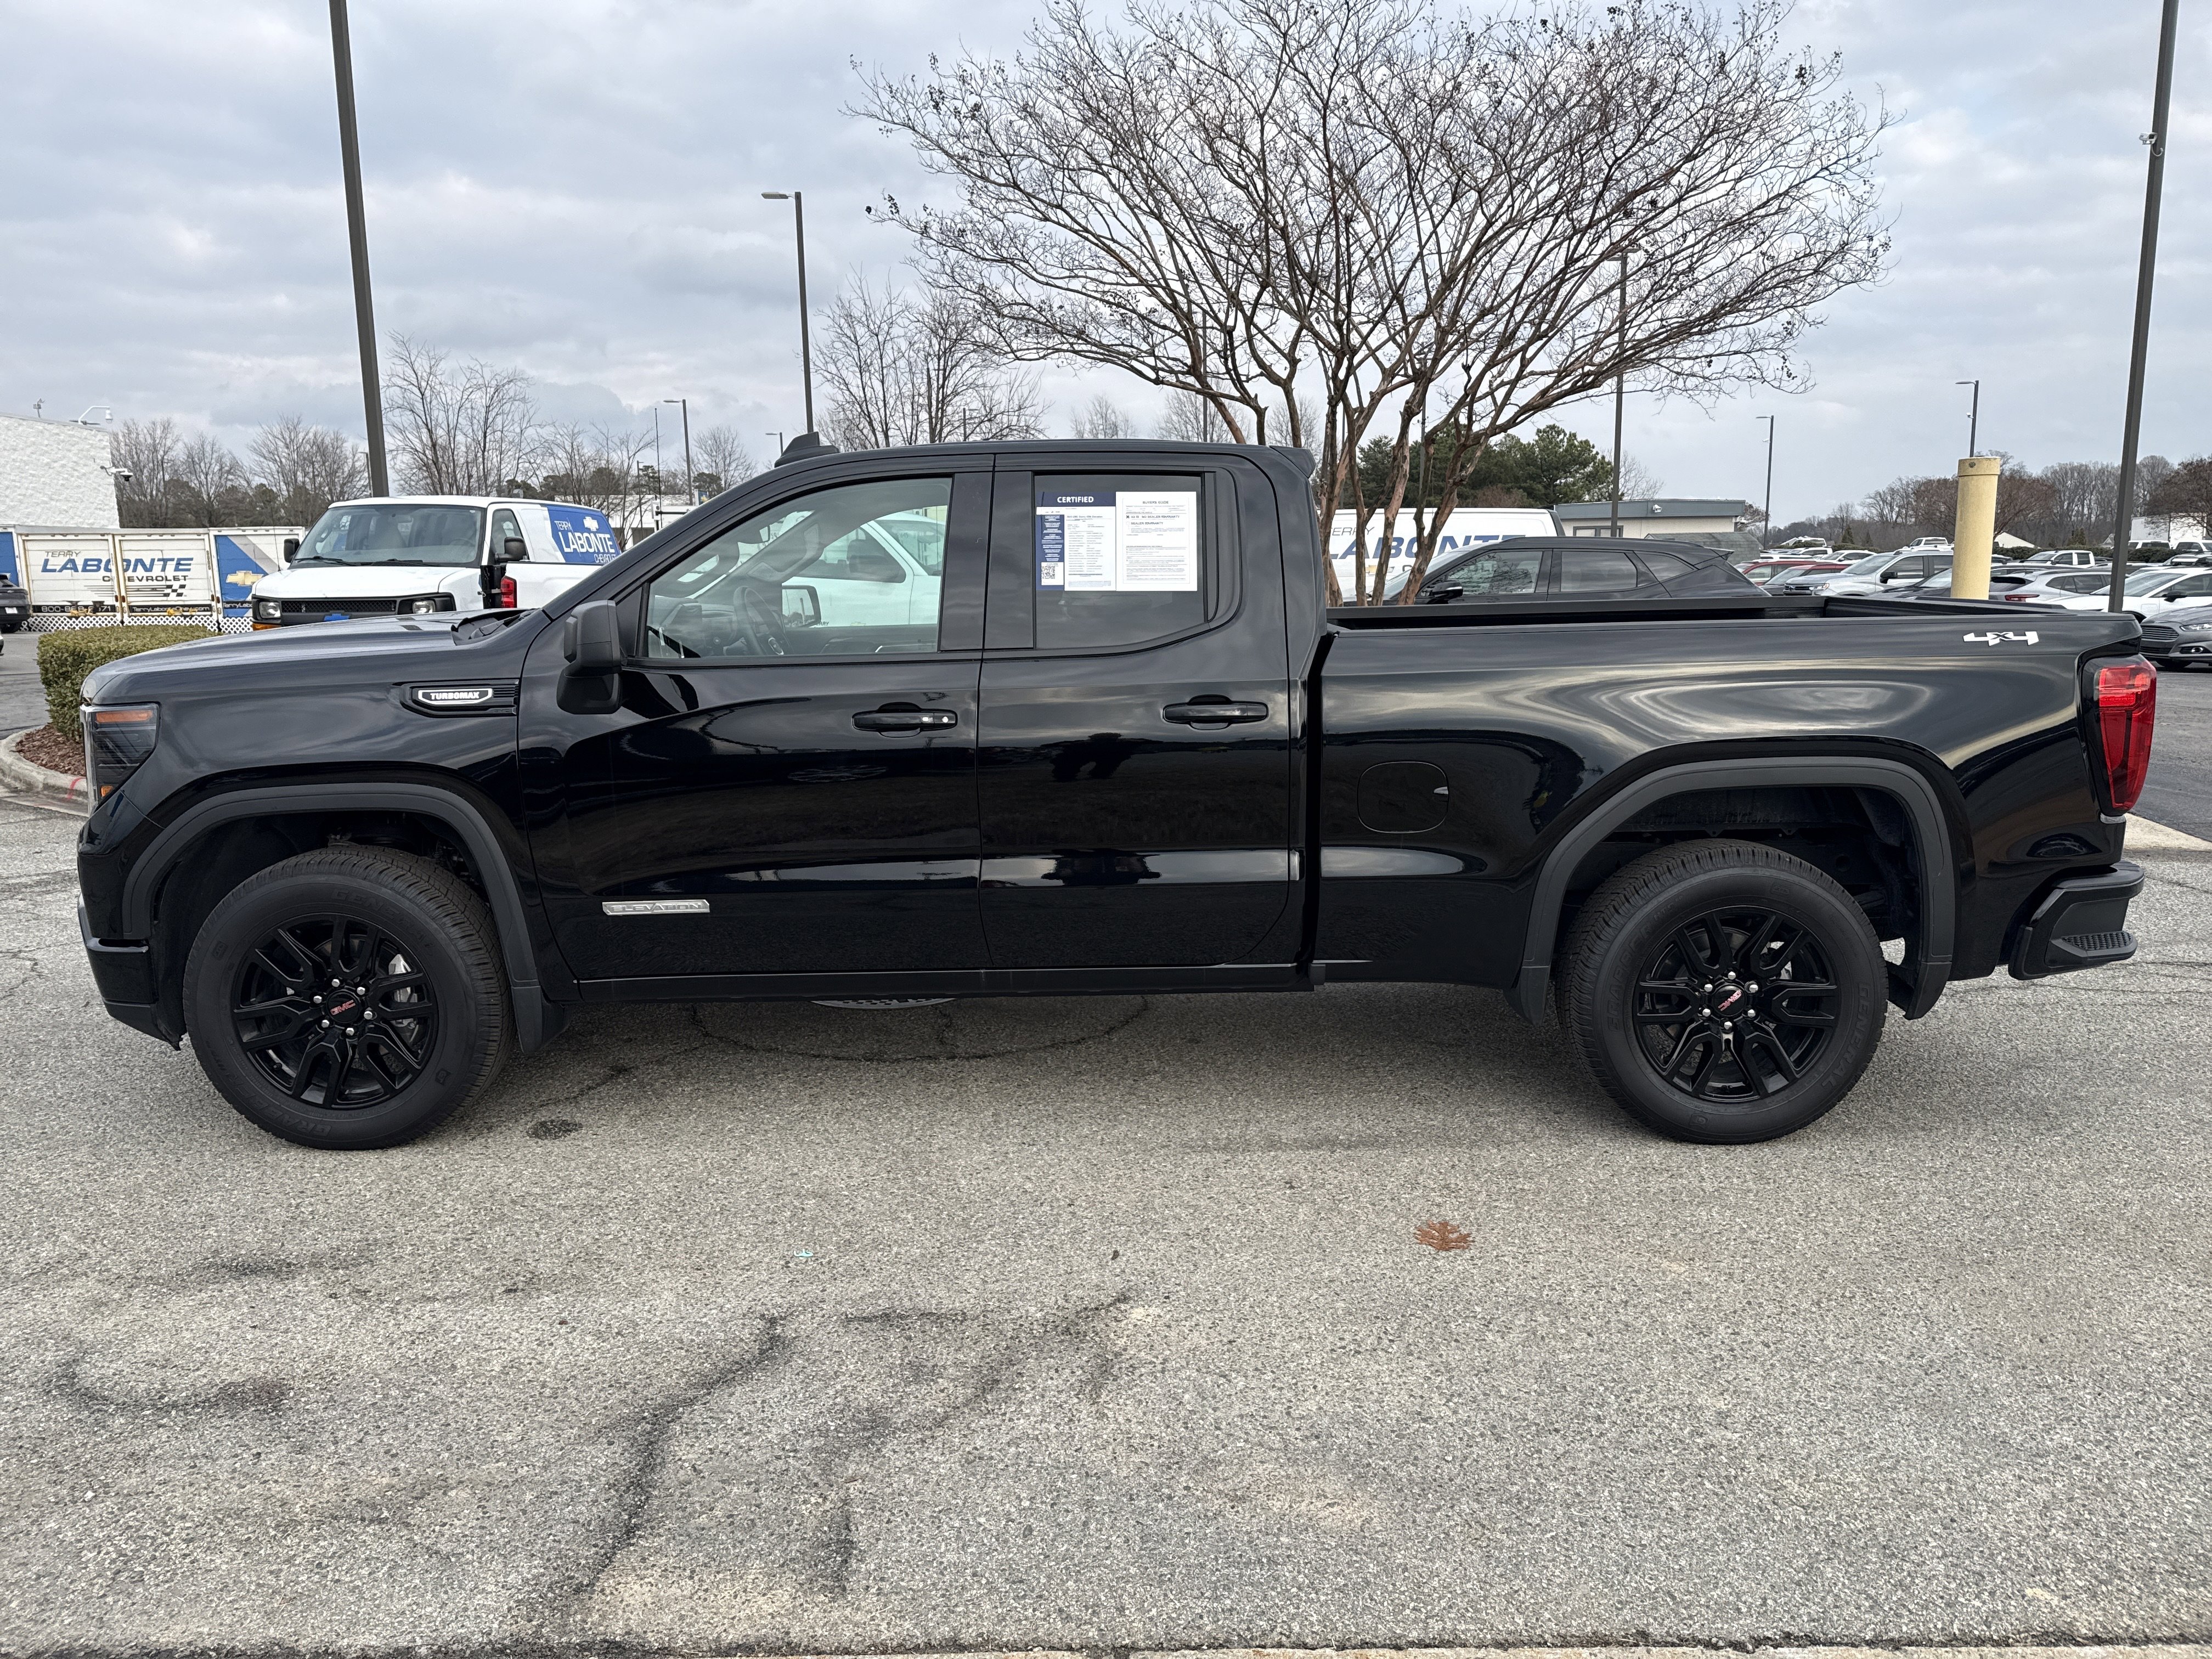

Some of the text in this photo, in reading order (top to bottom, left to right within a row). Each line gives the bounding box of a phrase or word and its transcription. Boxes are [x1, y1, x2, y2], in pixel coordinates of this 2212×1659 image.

[1331, 526, 1375, 536] ERY
[558, 531, 616, 554] LABONTE
[1329, 534, 1526, 560] ABNT
[41, 557, 194, 573] LABONTE
[611, 902, 702, 912] ELEVATION
[330, 1000, 356, 1015] GMC
[1718, 990, 1742, 1011] GMC
